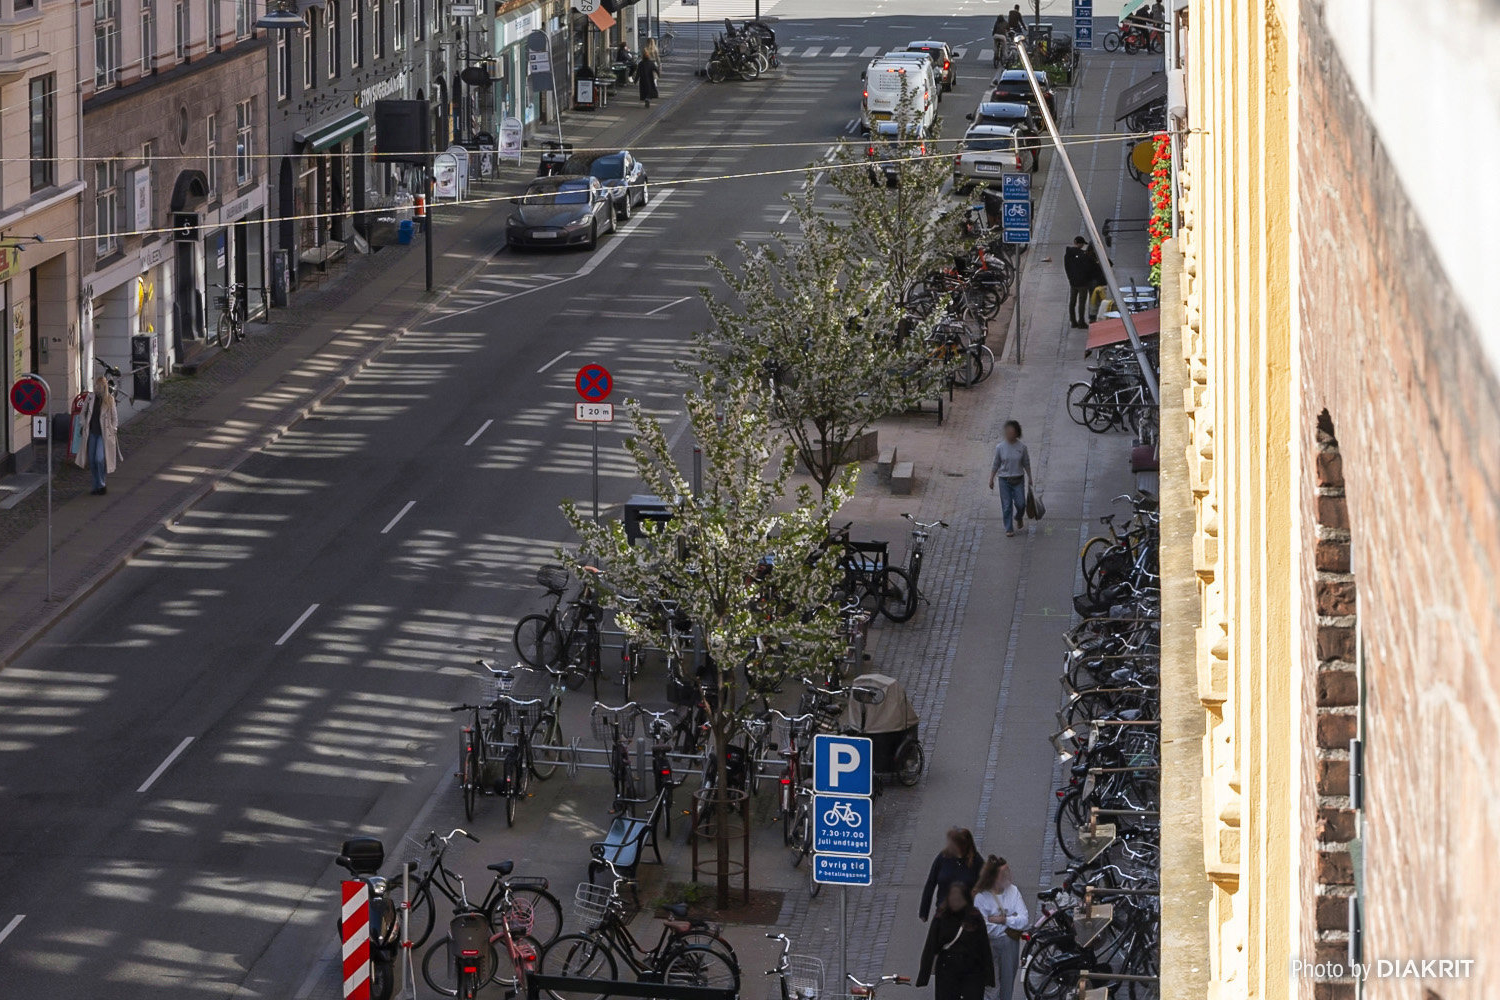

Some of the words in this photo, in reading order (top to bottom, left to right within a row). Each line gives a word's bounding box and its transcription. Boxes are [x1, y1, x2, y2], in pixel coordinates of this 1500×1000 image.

[1006, 177, 1012, 185] P
[829, 742, 861, 788] P
[817, 838, 831, 846] Juli
[833, 839, 868, 848] undtaget
[820, 859, 847, 871] Øvrig
[850, 861, 865, 870] tid
